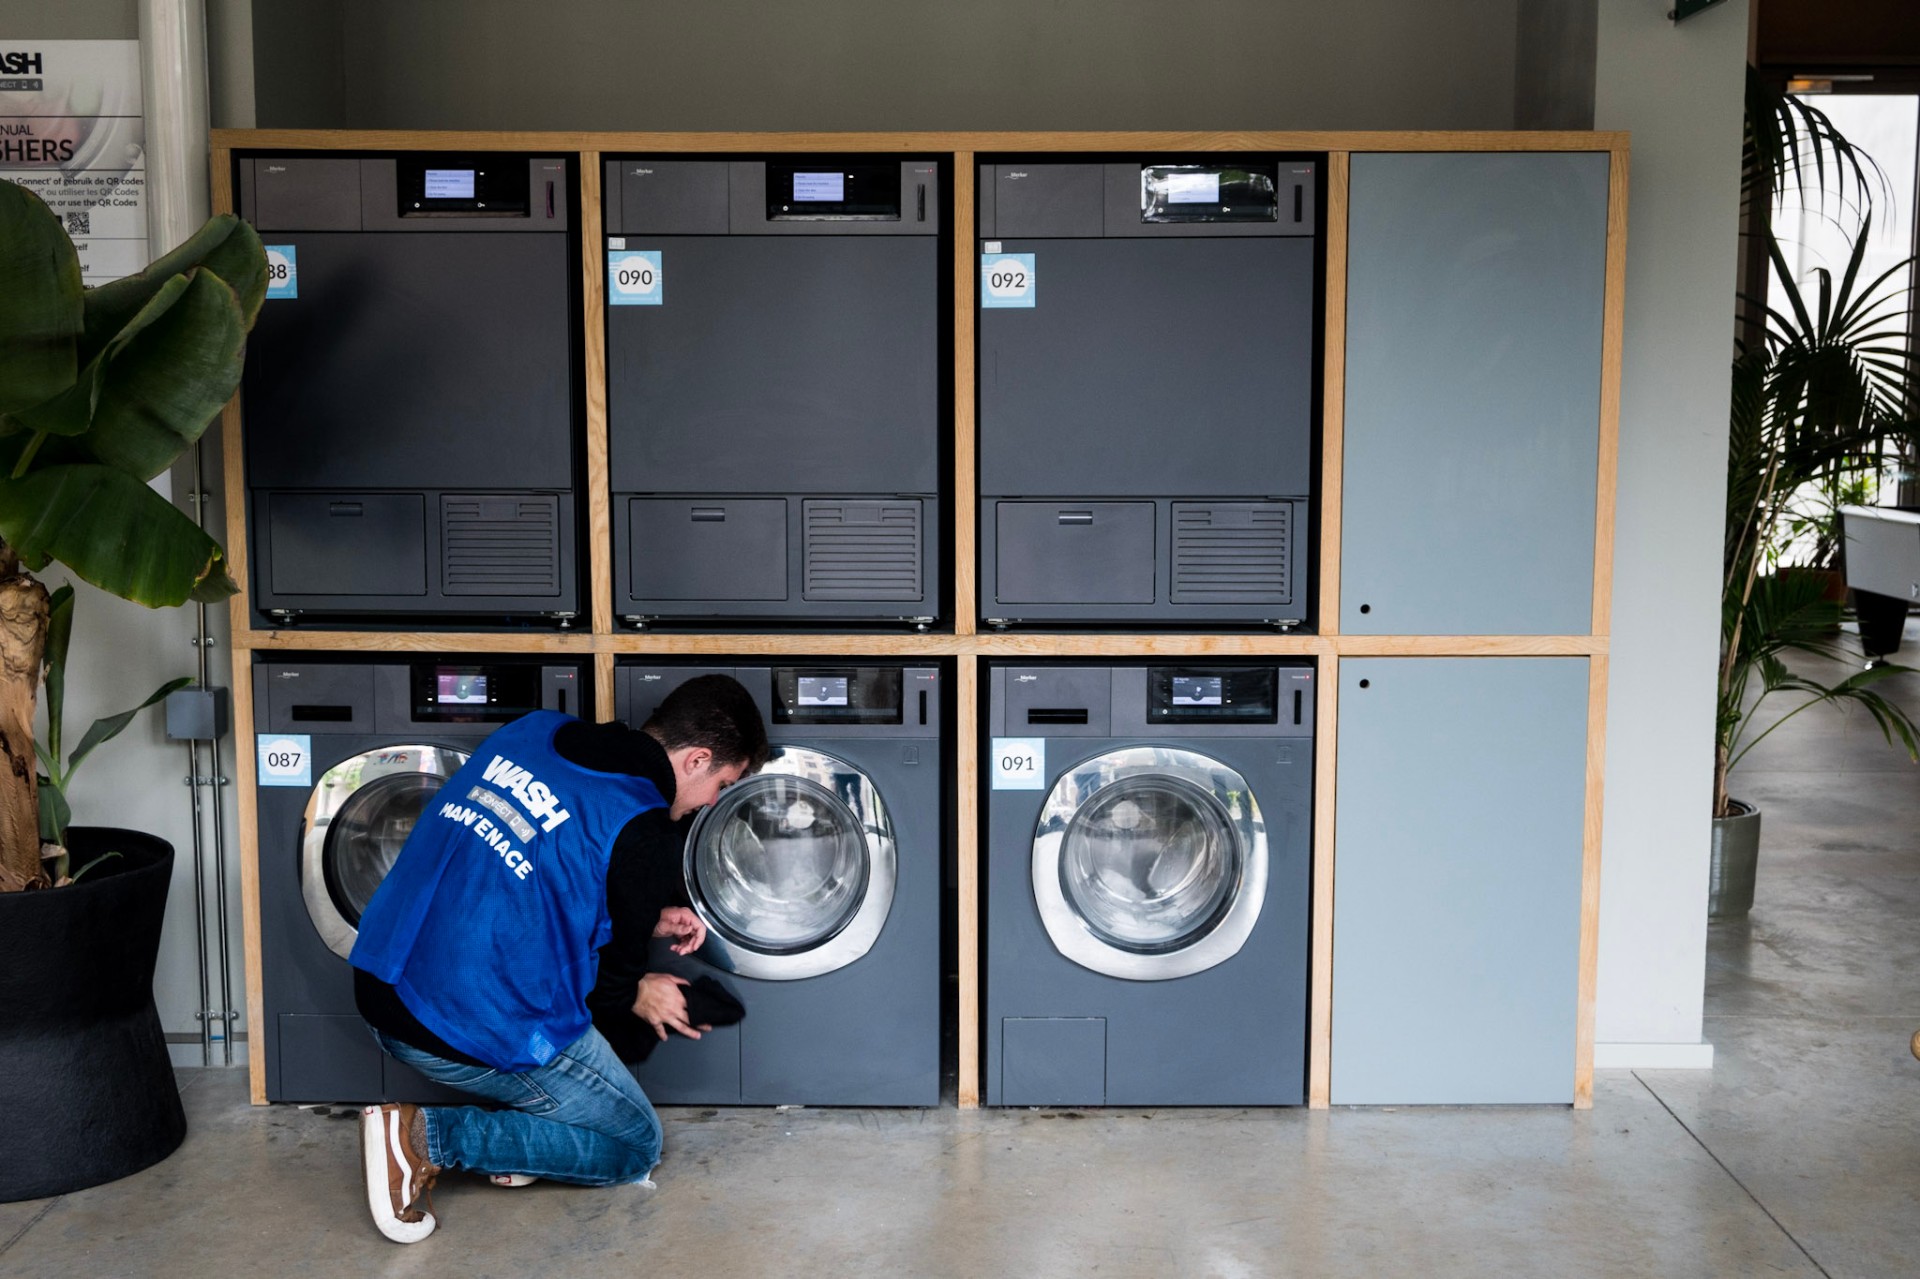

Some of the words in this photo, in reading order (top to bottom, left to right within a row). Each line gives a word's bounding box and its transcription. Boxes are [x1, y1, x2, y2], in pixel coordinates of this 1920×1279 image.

[0, 139, 73, 161] HERS
[53, 177, 61, 185] of
[63, 177, 93, 186] gebruik
[94, 177, 105, 185] de
[106, 177, 119, 186] QR
[121, 177, 144, 185] codes
[99, 188, 113, 197] QR
[114, 188, 139, 196] Codes
[83, 198, 97, 206] the
[98, 199, 112, 207] QR
[619, 270, 652, 285] 090
[991, 272, 1025, 288] 092
[268, 752, 301, 767] 087
[1002, 756, 1034, 771] 091
[481, 754, 571, 833] WASH
